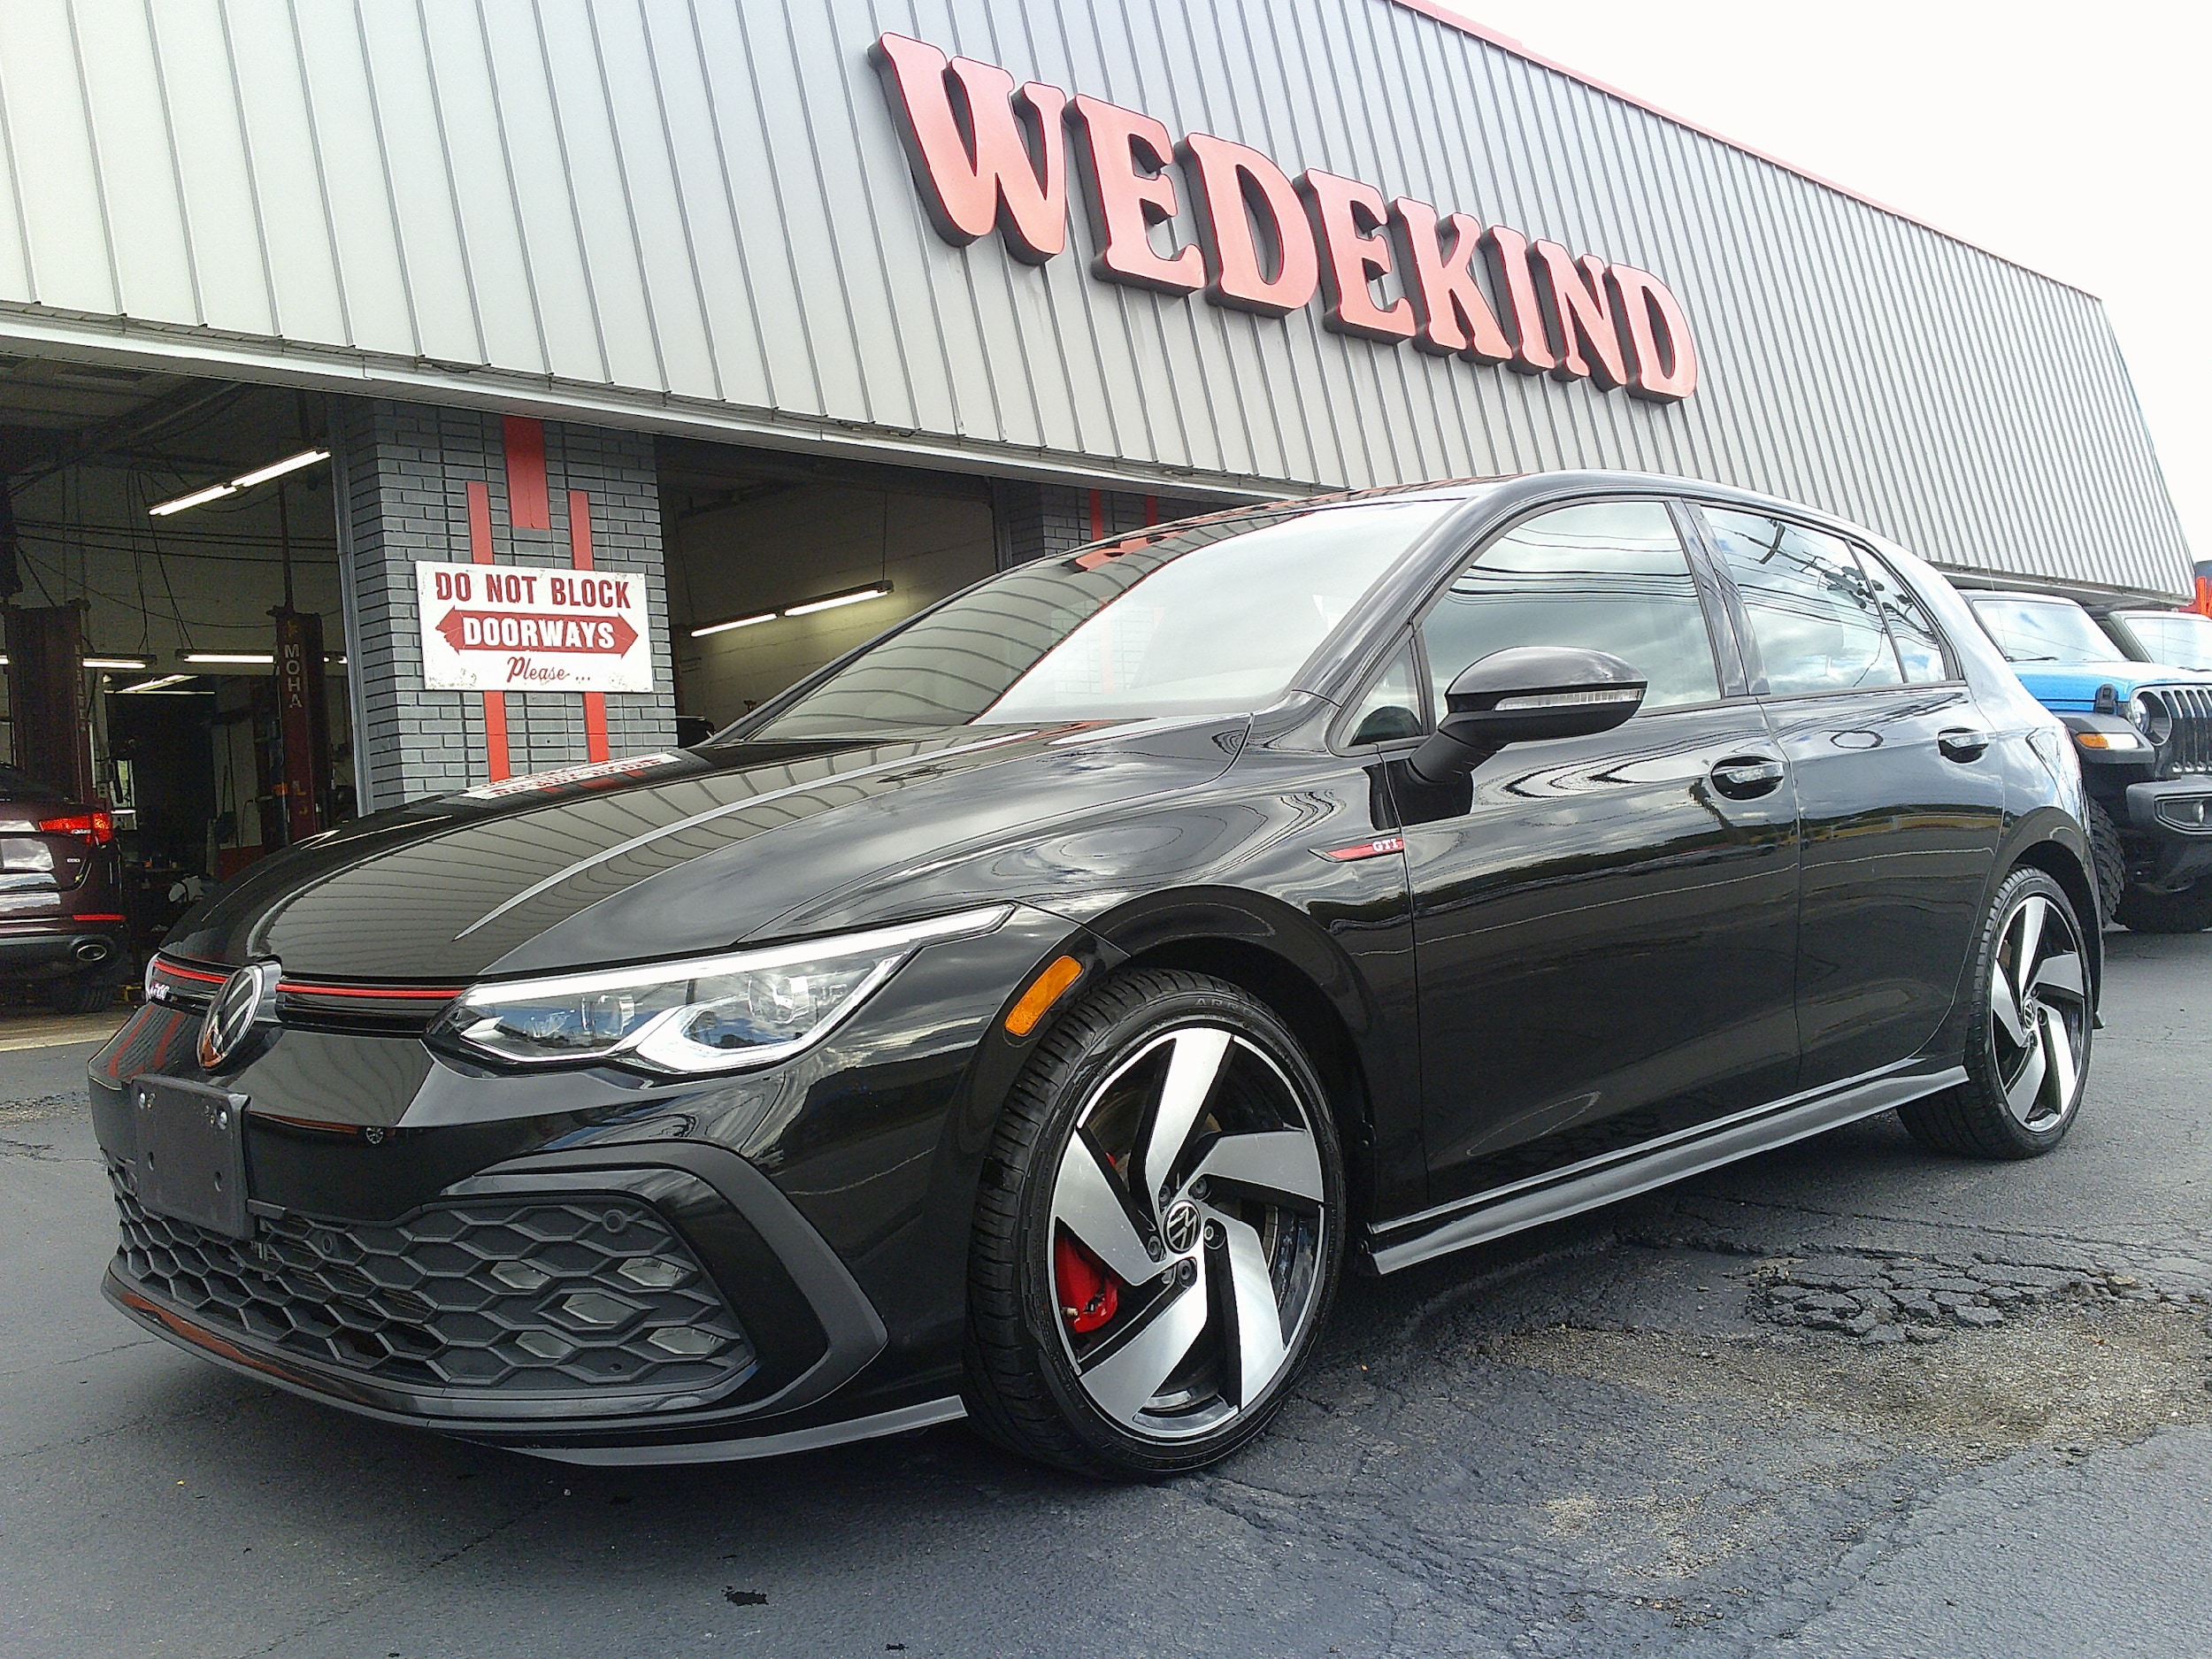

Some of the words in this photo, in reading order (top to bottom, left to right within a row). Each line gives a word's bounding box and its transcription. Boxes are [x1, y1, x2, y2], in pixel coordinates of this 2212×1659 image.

[870, 32, 1698, 403] WEDEKIND
[434, 572, 472, 602] DO
[486, 573, 537, 603] NOT
[550, 577, 631, 609] BLOCK
[462, 616, 616, 649] DOORWAYS
[506, 656, 571, 682] Please
[1372, 838, 1398, 852] GTI
